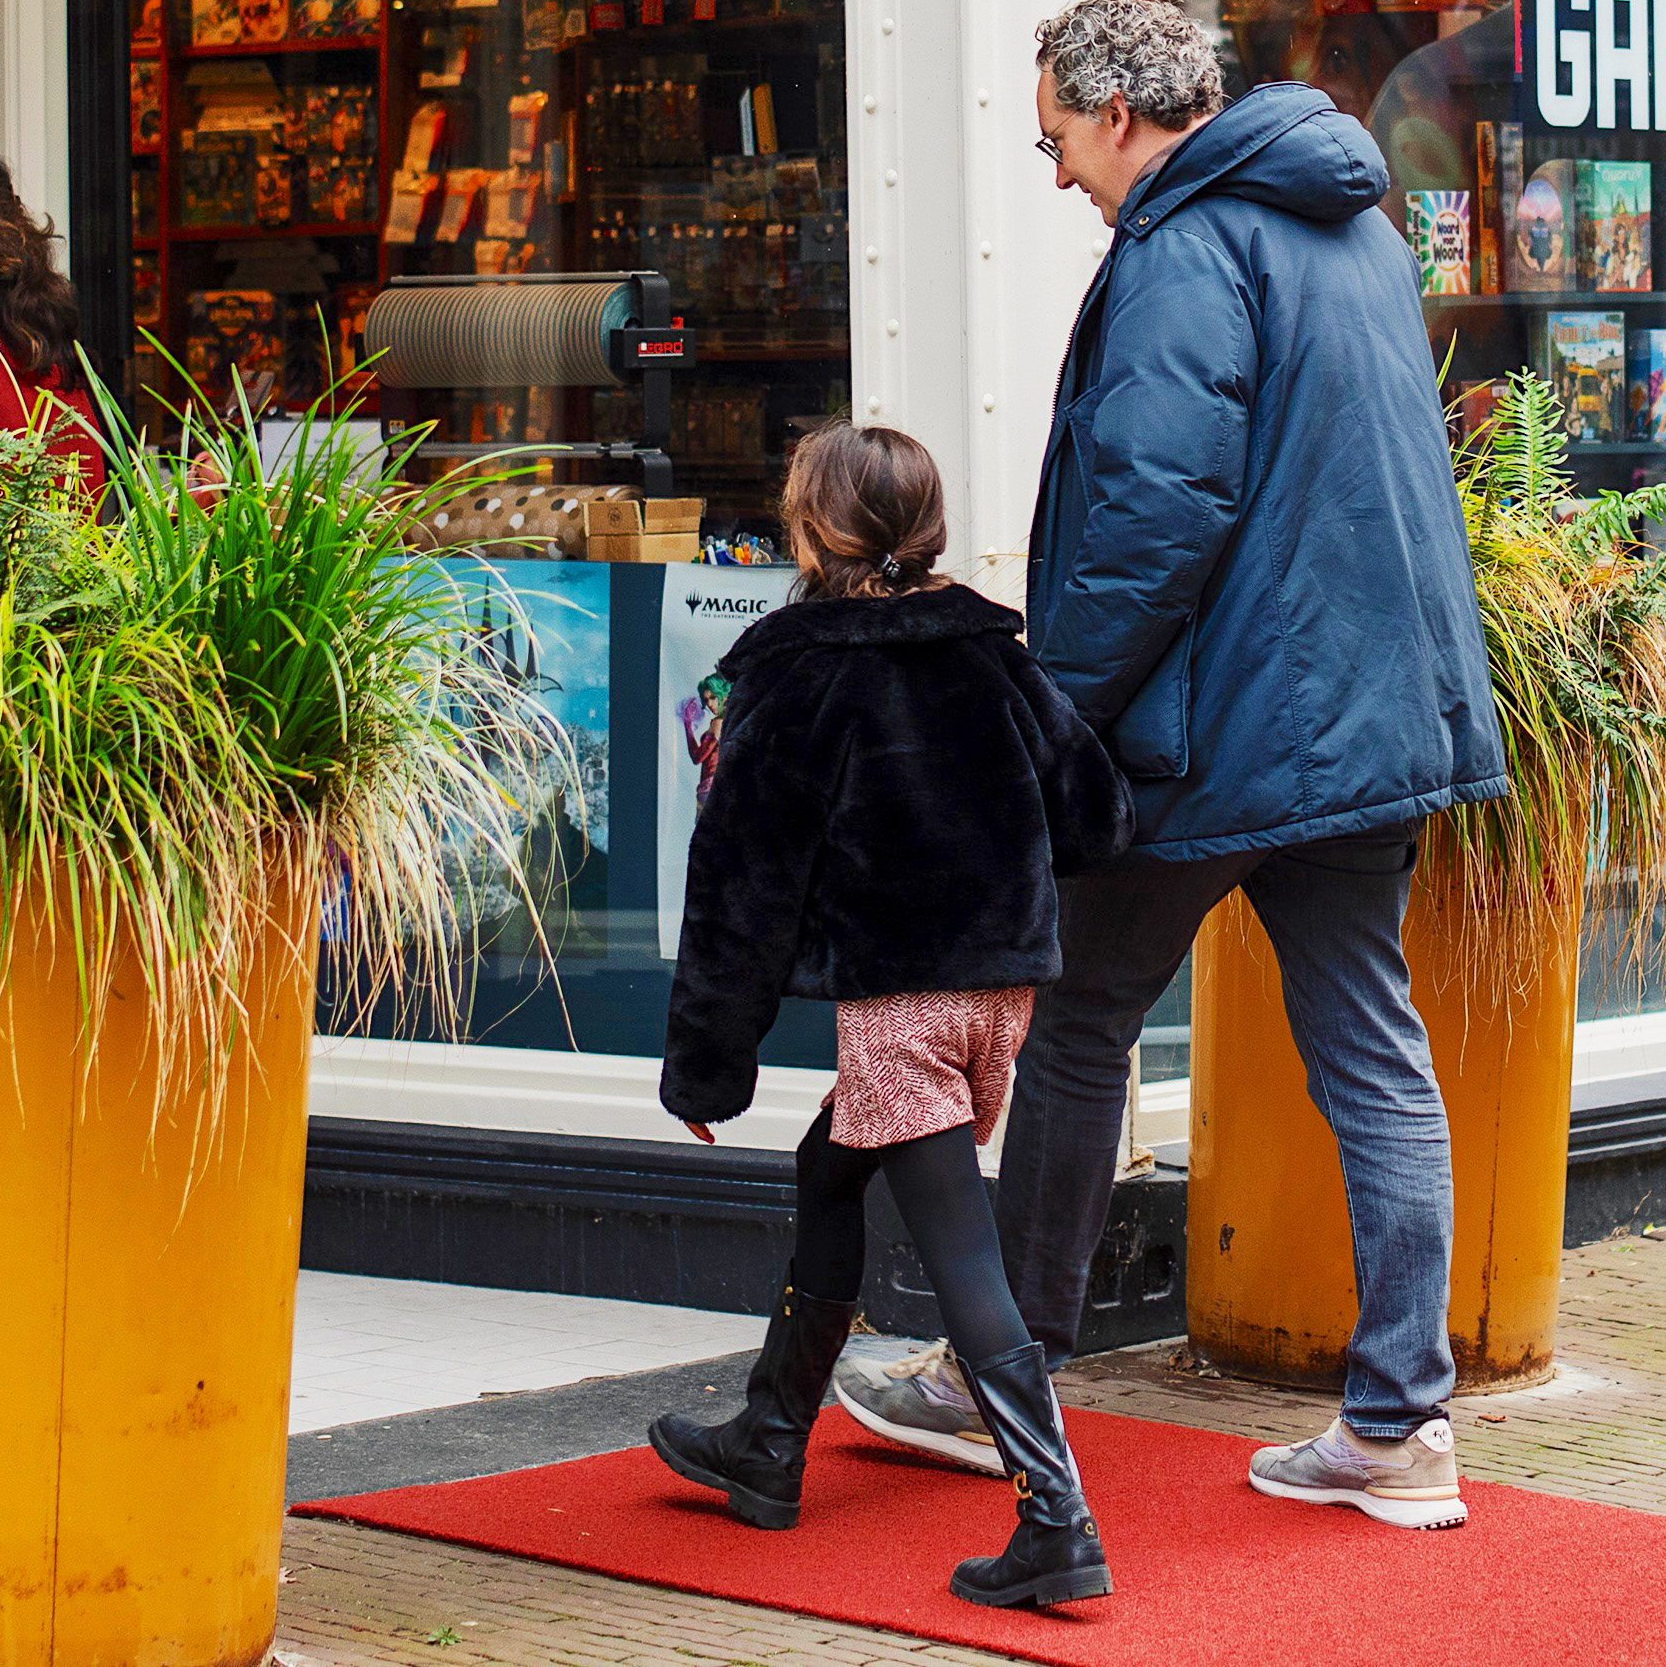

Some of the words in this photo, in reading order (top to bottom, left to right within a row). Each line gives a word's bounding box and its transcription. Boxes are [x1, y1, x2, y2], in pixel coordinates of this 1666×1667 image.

[1436, 217, 1460, 235] Woord
[1443, 237, 1455, 245] voor
[1433, 239, 1464, 263] Woord
[702, 597, 768, 613] MAGIC
